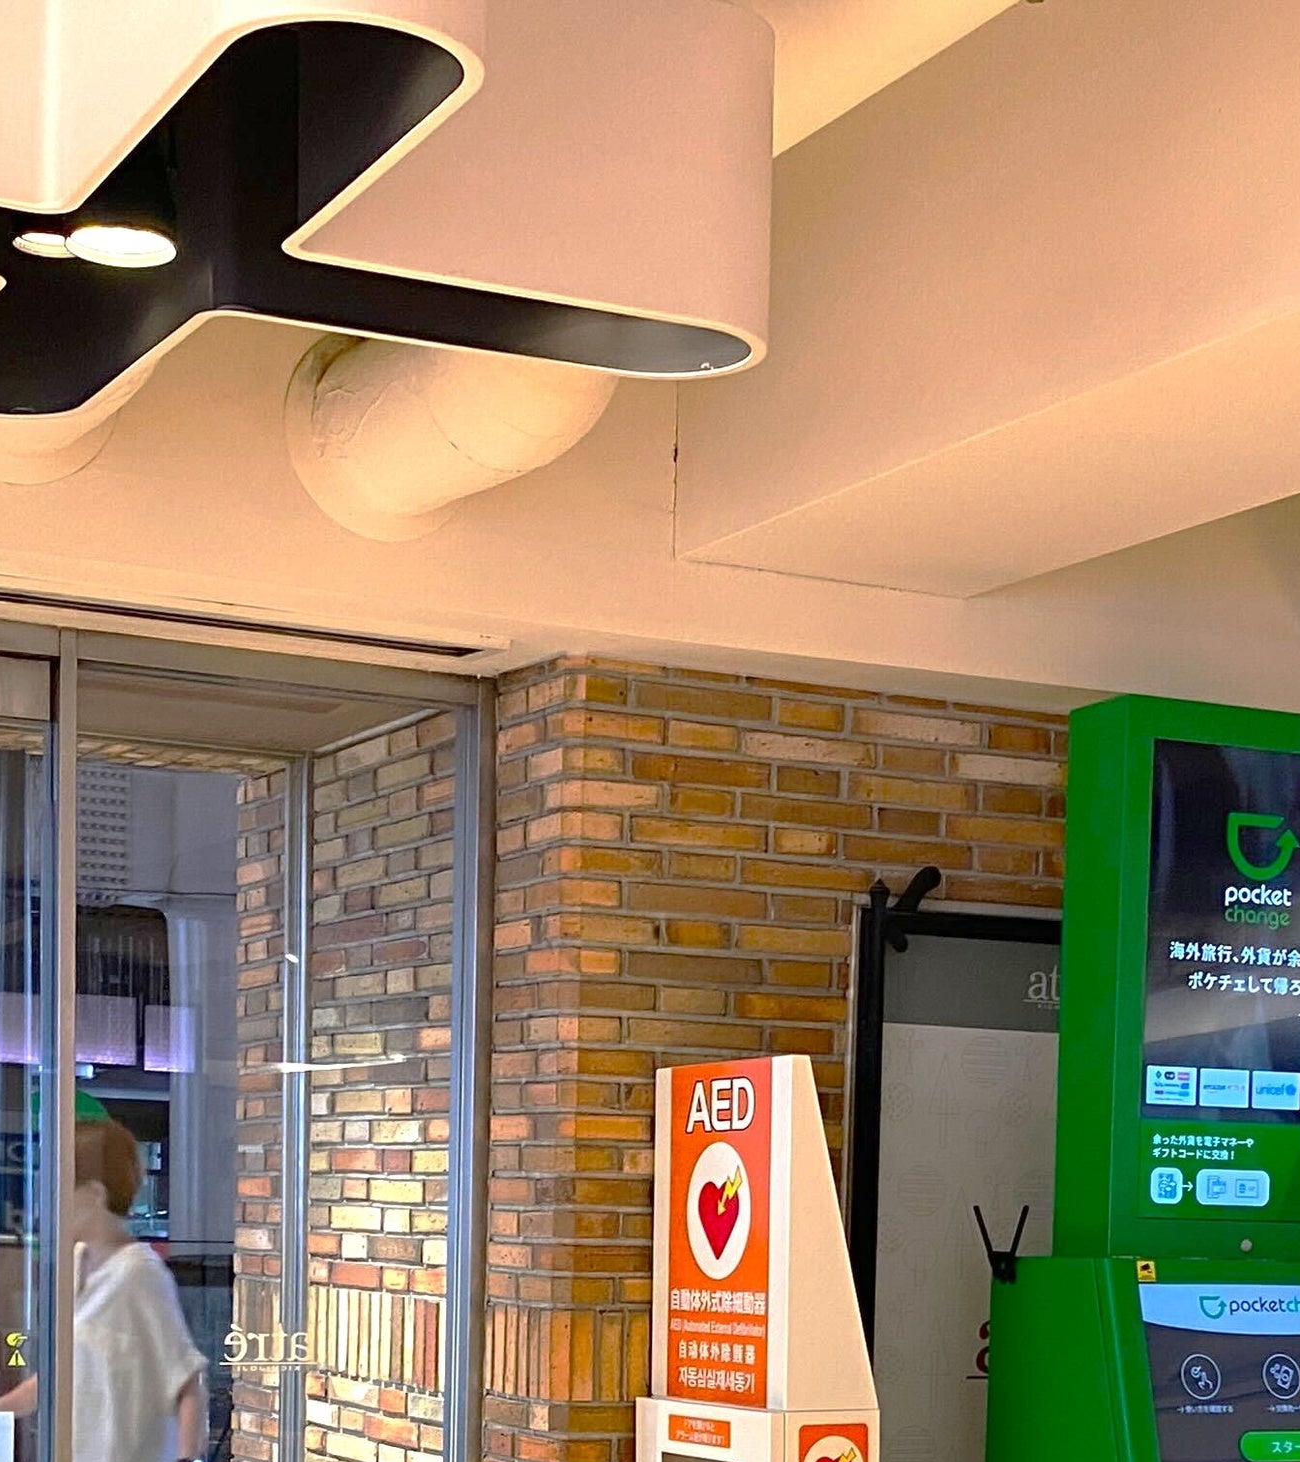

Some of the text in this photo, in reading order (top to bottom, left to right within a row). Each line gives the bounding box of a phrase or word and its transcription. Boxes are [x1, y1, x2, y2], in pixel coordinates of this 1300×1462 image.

[1224, 884, 1292, 907] pocket
[1224, 905, 1291, 930] change
[1028, 964, 1060, 1001] at
[1255, 1082, 1286, 1096] unicef
[684, 1076, 756, 1135] AED
[670, 1287, 766, 1317] 自動体外式除細動器
